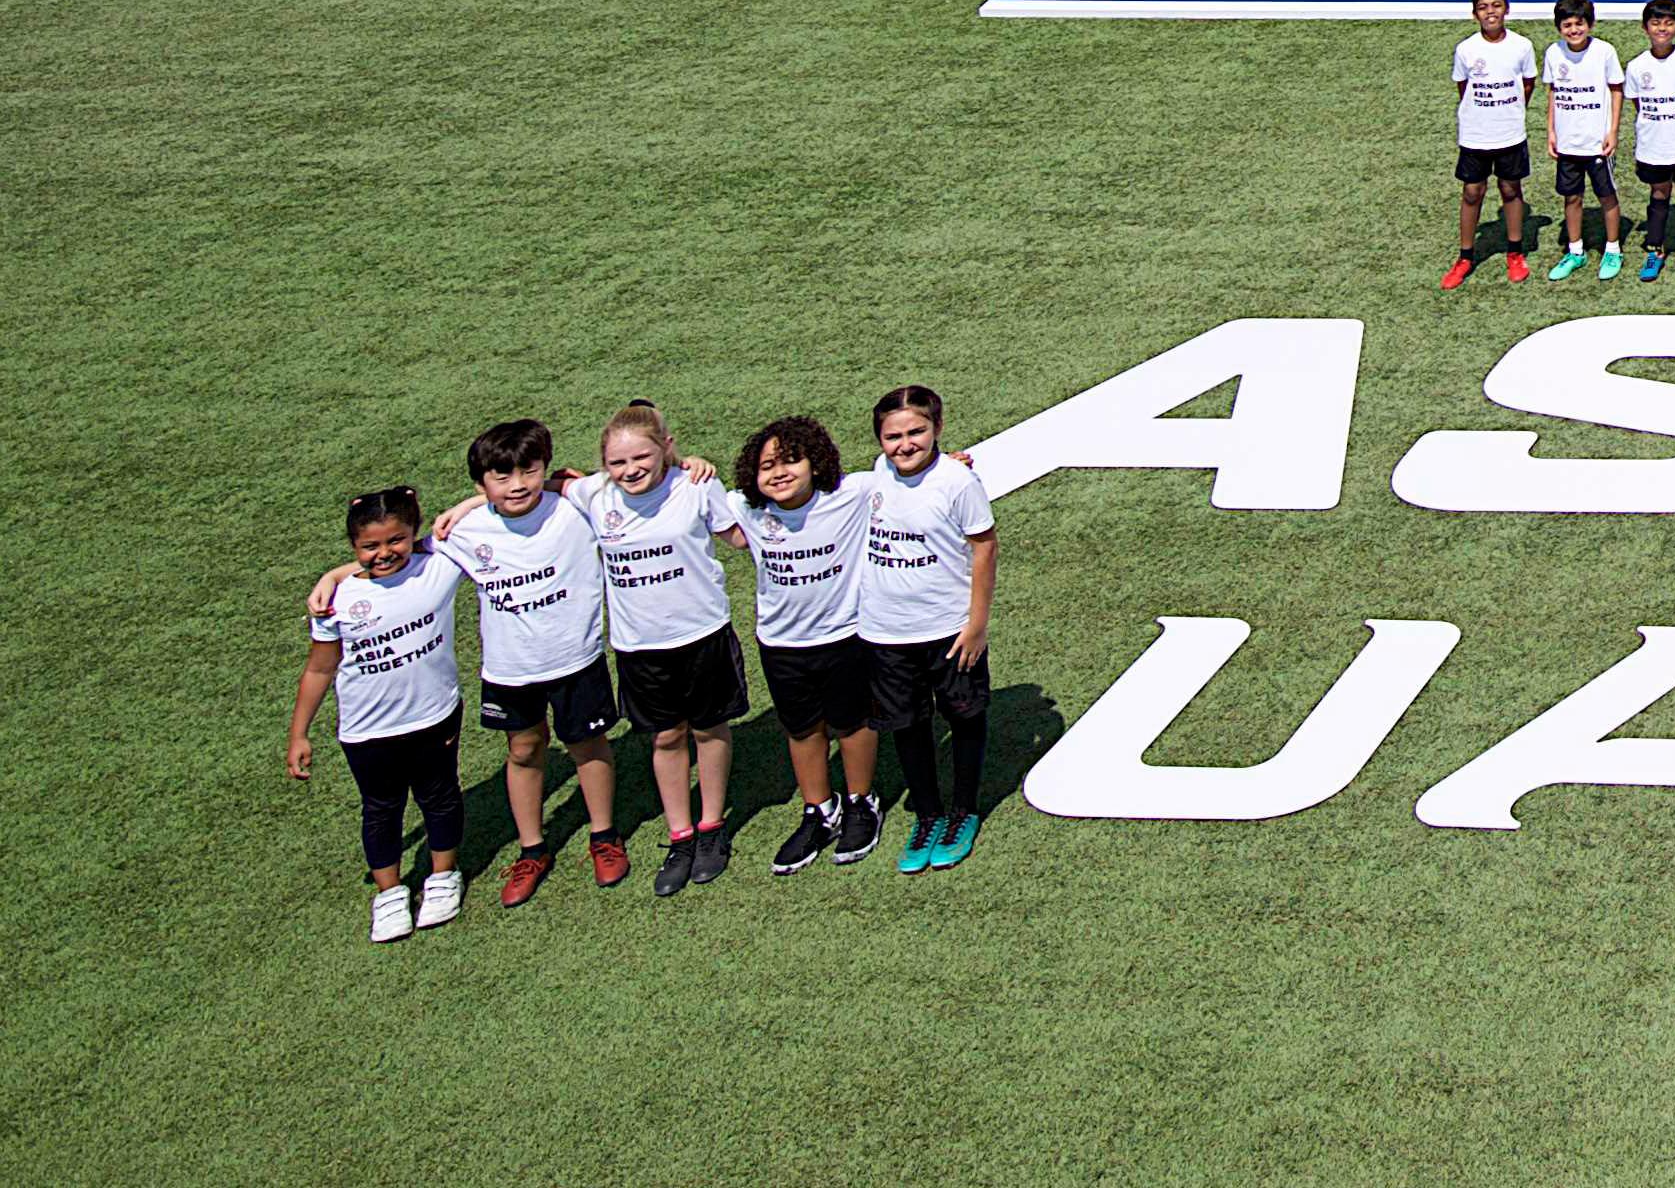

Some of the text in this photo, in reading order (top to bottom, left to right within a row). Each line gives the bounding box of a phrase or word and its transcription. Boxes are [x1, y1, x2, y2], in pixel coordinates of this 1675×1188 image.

[479, 566, 556, 592] RINGING
[355, 646, 395, 664] ASIA
[358, 633, 444, 675] TOGETHER
